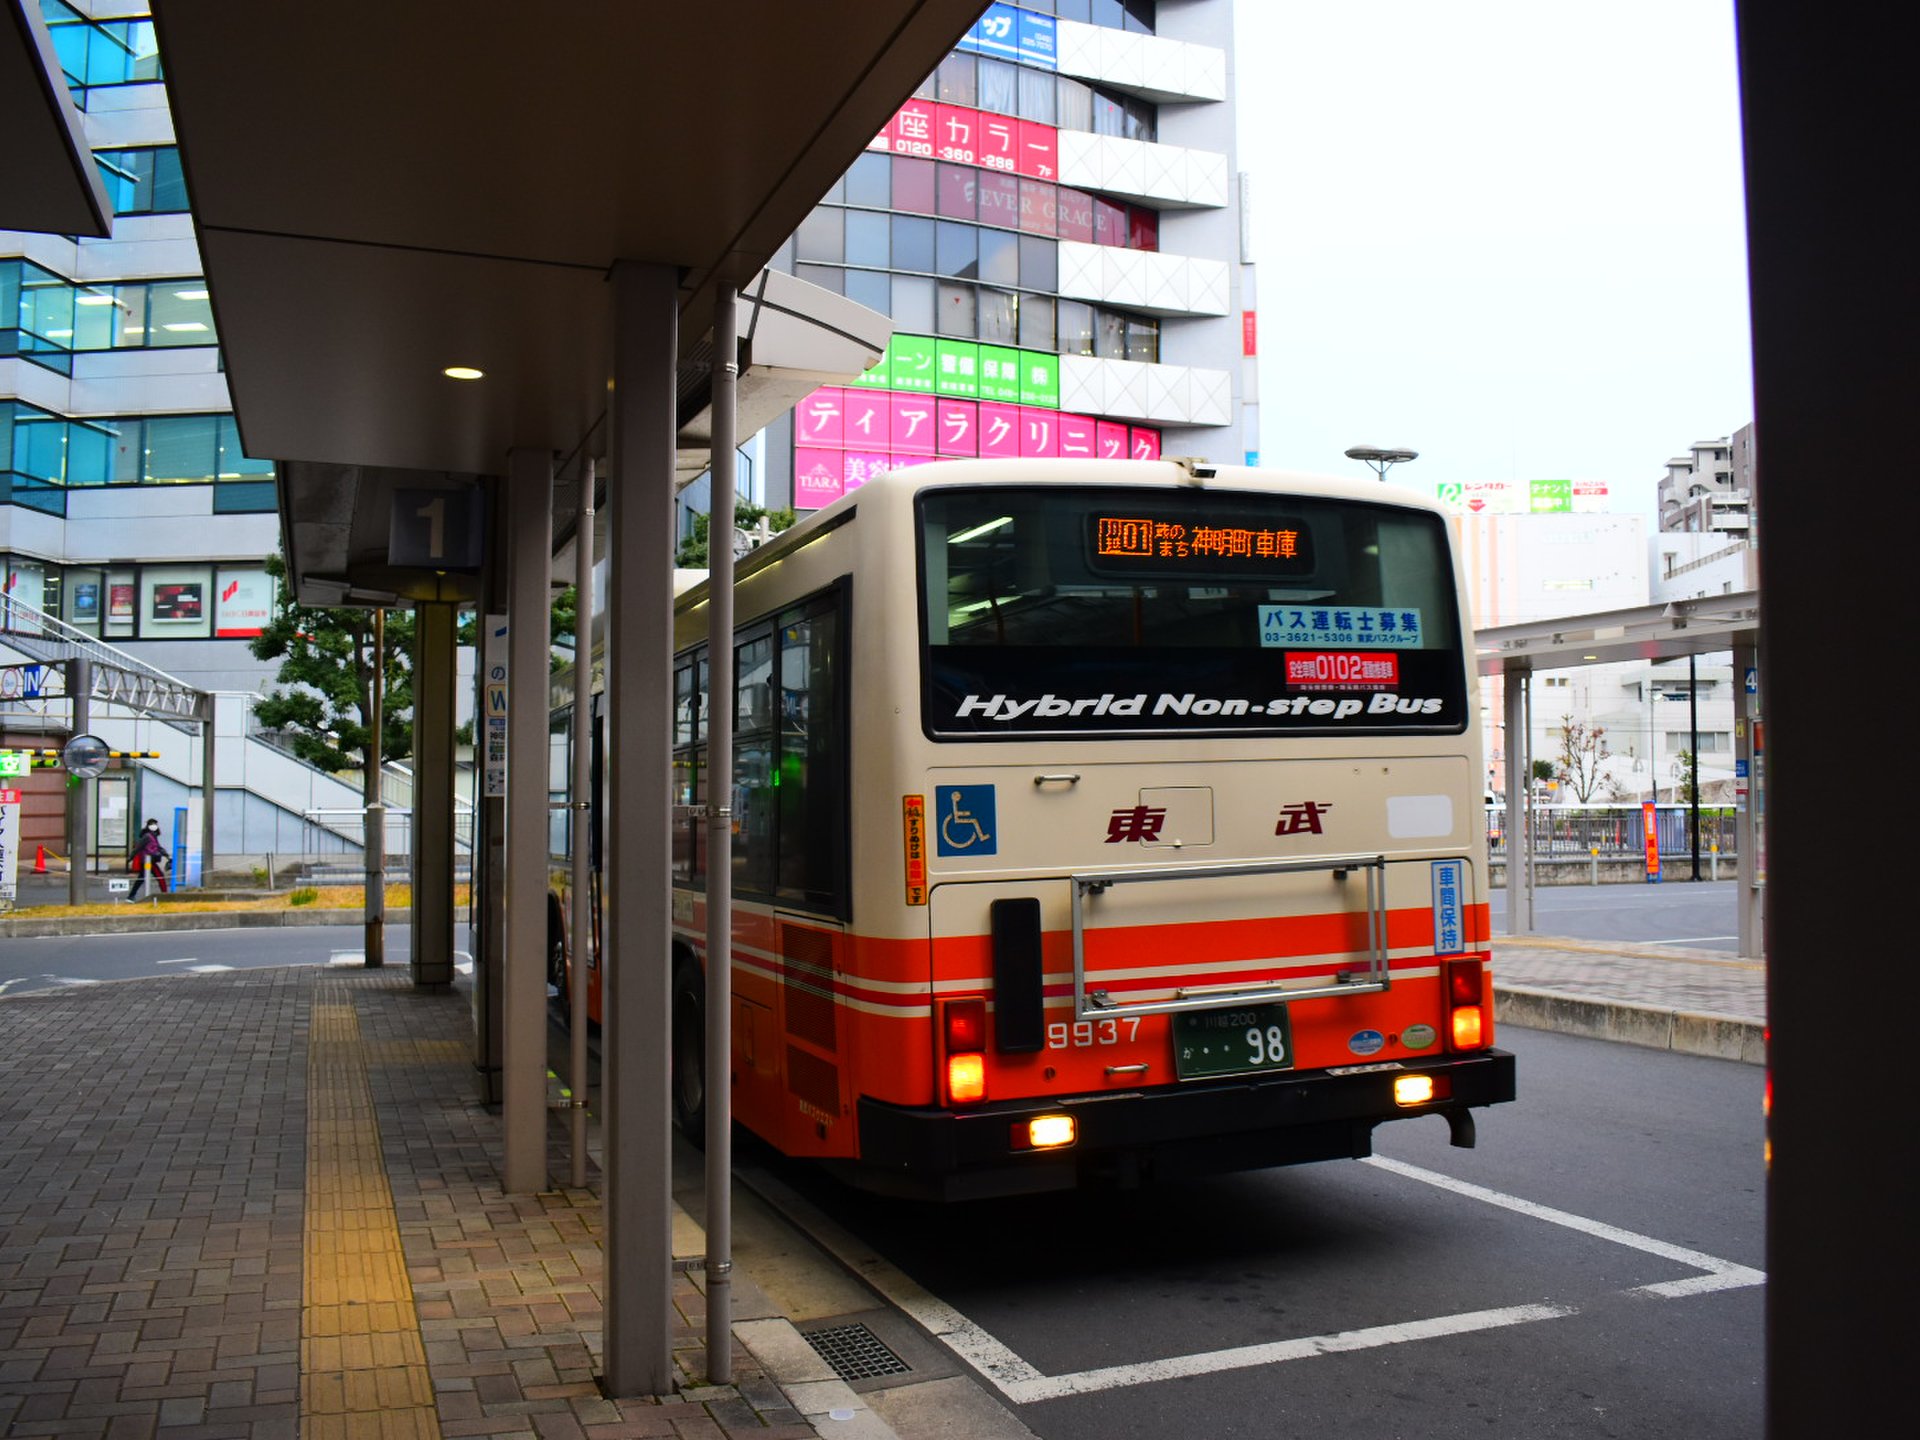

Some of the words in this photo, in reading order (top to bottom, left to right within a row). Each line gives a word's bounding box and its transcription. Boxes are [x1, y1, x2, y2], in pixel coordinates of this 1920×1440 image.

[980, 188, 1033, 214] EVER
[1043, 202, 1107, 232] GRACE
[809, 402, 1152, 460] ティアラクリニック
[799, 475, 841, 489] TIARA
[1532, 482, 1570, 494] テナント
[416, 499, 445, 558] 1
[1191, 525, 1298, 558] 神明町車庫
[1265, 609, 1418, 632] バス運転士募集
[1265, 632, 1353, 642] 03-3621-5306
[24, 671, 39, 692] IN
[1745, 676, 1757, 691] 4
[955, 693, 1148, 721] Hybrid
[1152, 693, 1364, 719] Non-step
[1367, 693, 1444, 714] Bus
[1439, 867, 1457, 950] 車間保持
[1048, 1016, 1141, 1049] 9937
